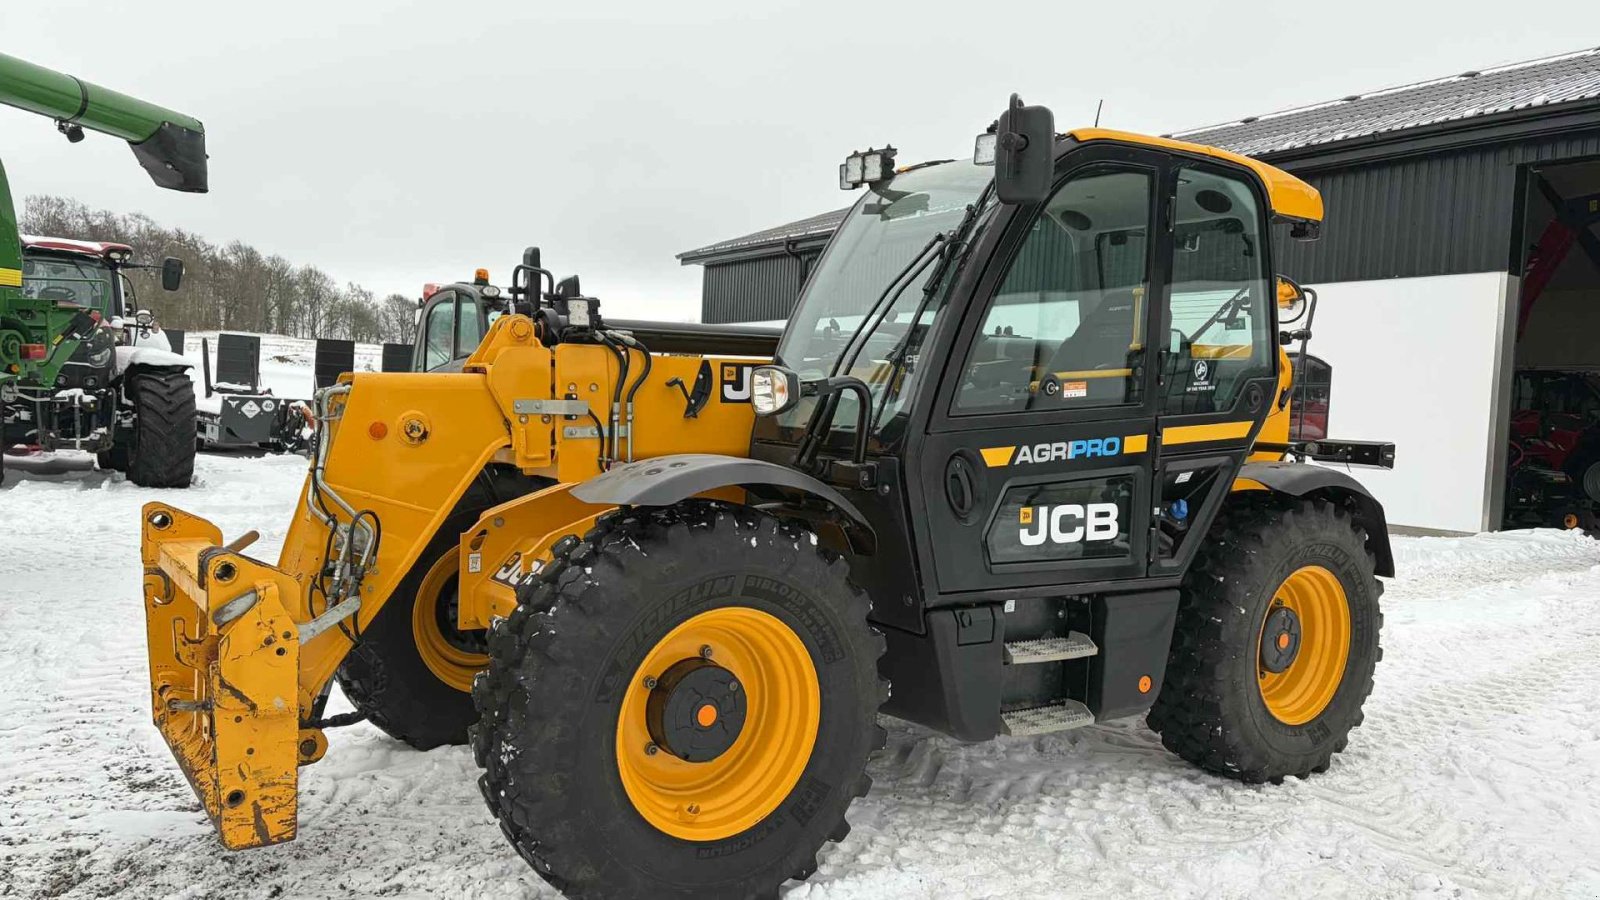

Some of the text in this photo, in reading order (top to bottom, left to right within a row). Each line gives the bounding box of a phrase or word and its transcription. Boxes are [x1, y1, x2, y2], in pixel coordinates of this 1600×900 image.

[1014, 437, 1120, 466] AGRIPRO
[1019, 503, 1119, 546] JCB
[745, 575, 807, 606] BIBLOAD
[614, 575, 736, 668] MICHELIN
